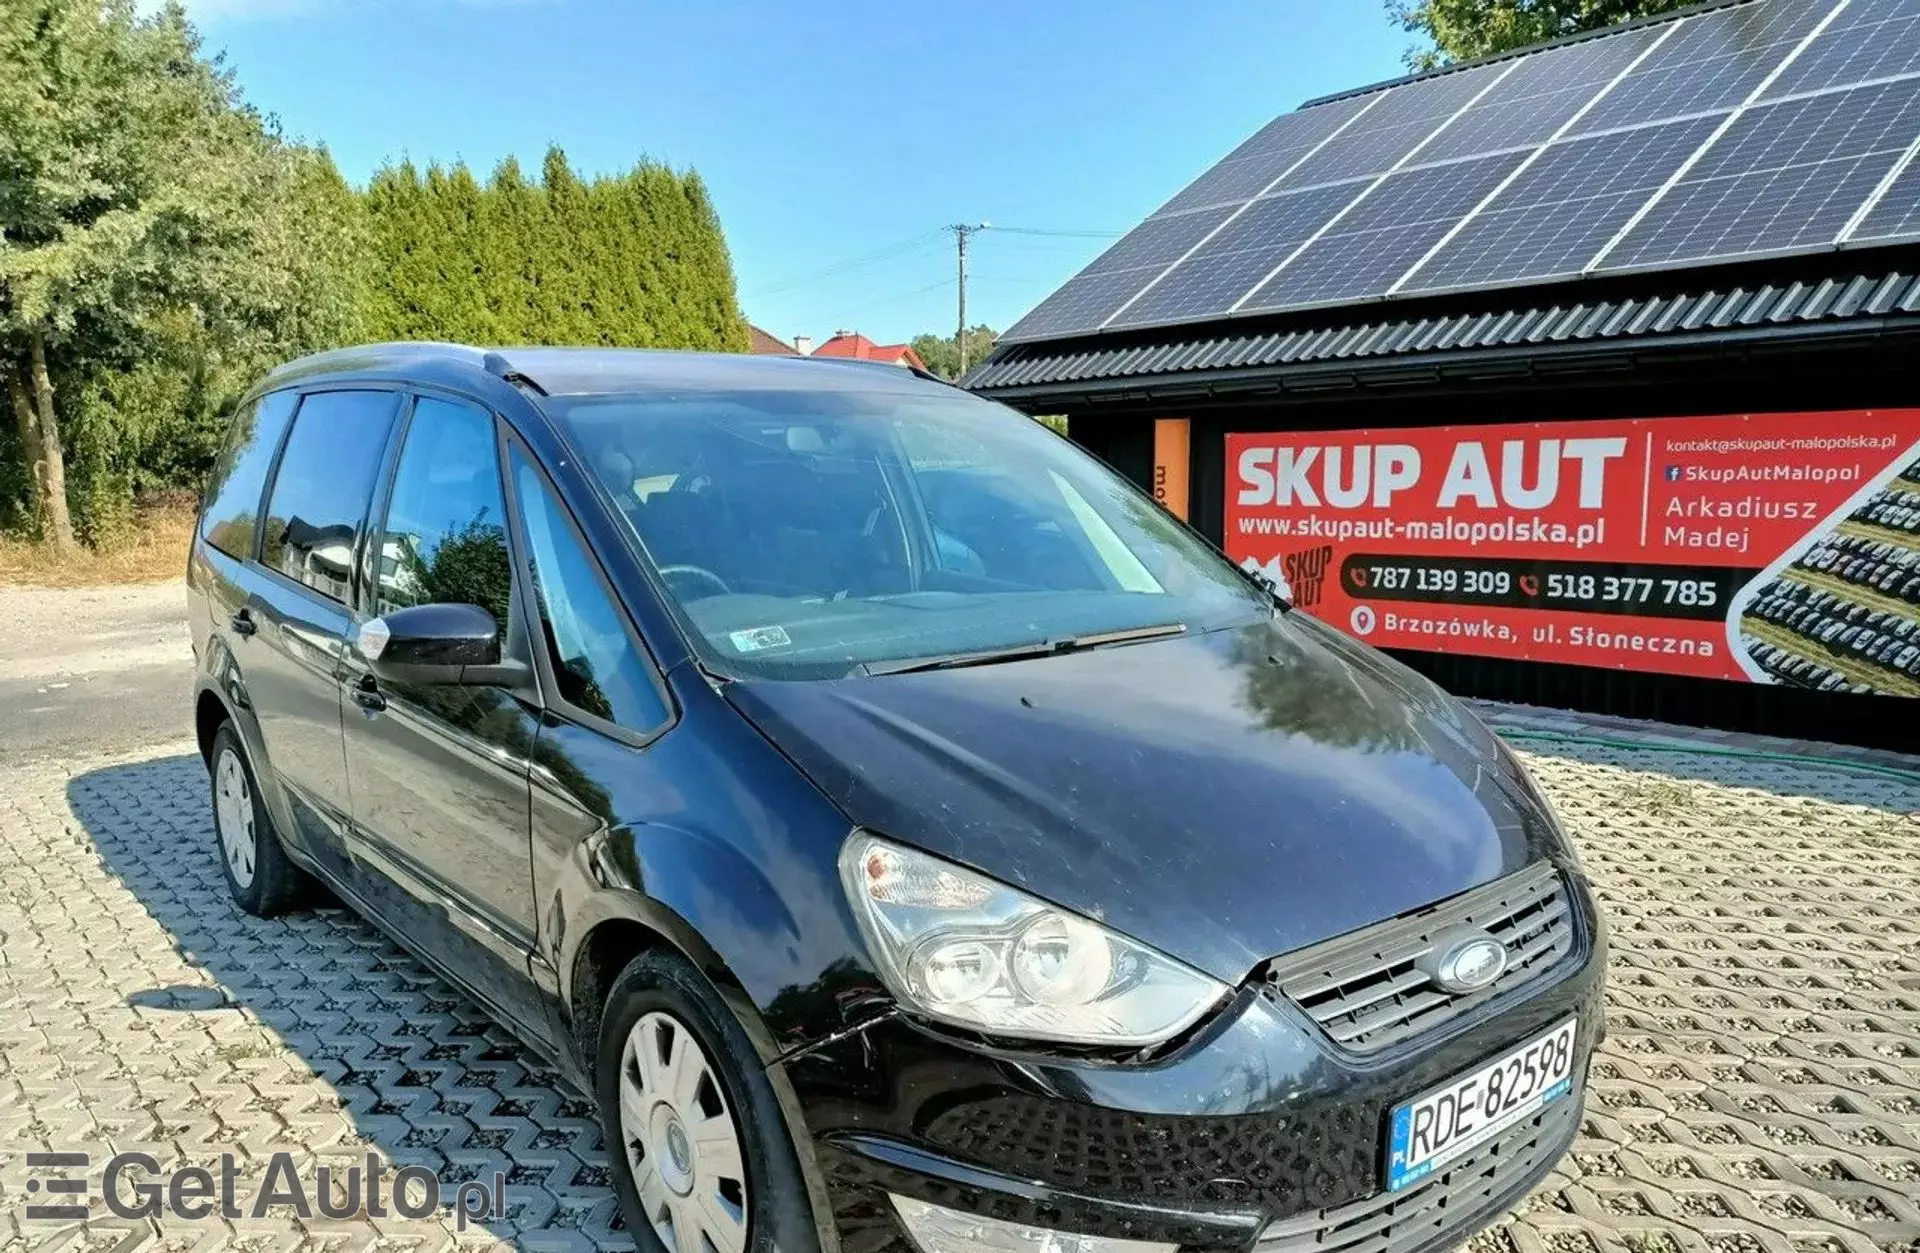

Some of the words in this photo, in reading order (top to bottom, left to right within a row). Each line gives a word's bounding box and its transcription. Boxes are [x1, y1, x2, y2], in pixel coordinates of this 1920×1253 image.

[1666, 434, 1896, 454] kontakt@skupaut-malopolska.pl
[1238, 444, 1421, 508] SKUP
[1436, 437, 1627, 508] AUT
[1686, 465, 1860, 484] SkupAutMalopol
[1666, 496, 1817, 520] Arkadiusz
[1239, 514, 1605, 548] www.skupaut-malopolska.pl
[1664, 526, 1749, 553] Madej
[1285, 545, 1333, 582] SKUP
[1293, 579, 1323, 608] AUT
[1370, 566, 1410, 589] 787
[1416, 568, 1457, 592] 139
[1463, 570, 1511, 594] 309
[1547, 574, 1596, 600] 518
[1602, 576, 1653, 603] 377
[1661, 580, 1717, 606] 785
[1385, 614, 1518, 642] Brzozówka,
[1532, 626, 1562, 644] ul.
[1570, 627, 1714, 657] Słoneczna
[1411, 1079, 1478, 1163] RDE
[1484, 1029, 1570, 1119] 82598
